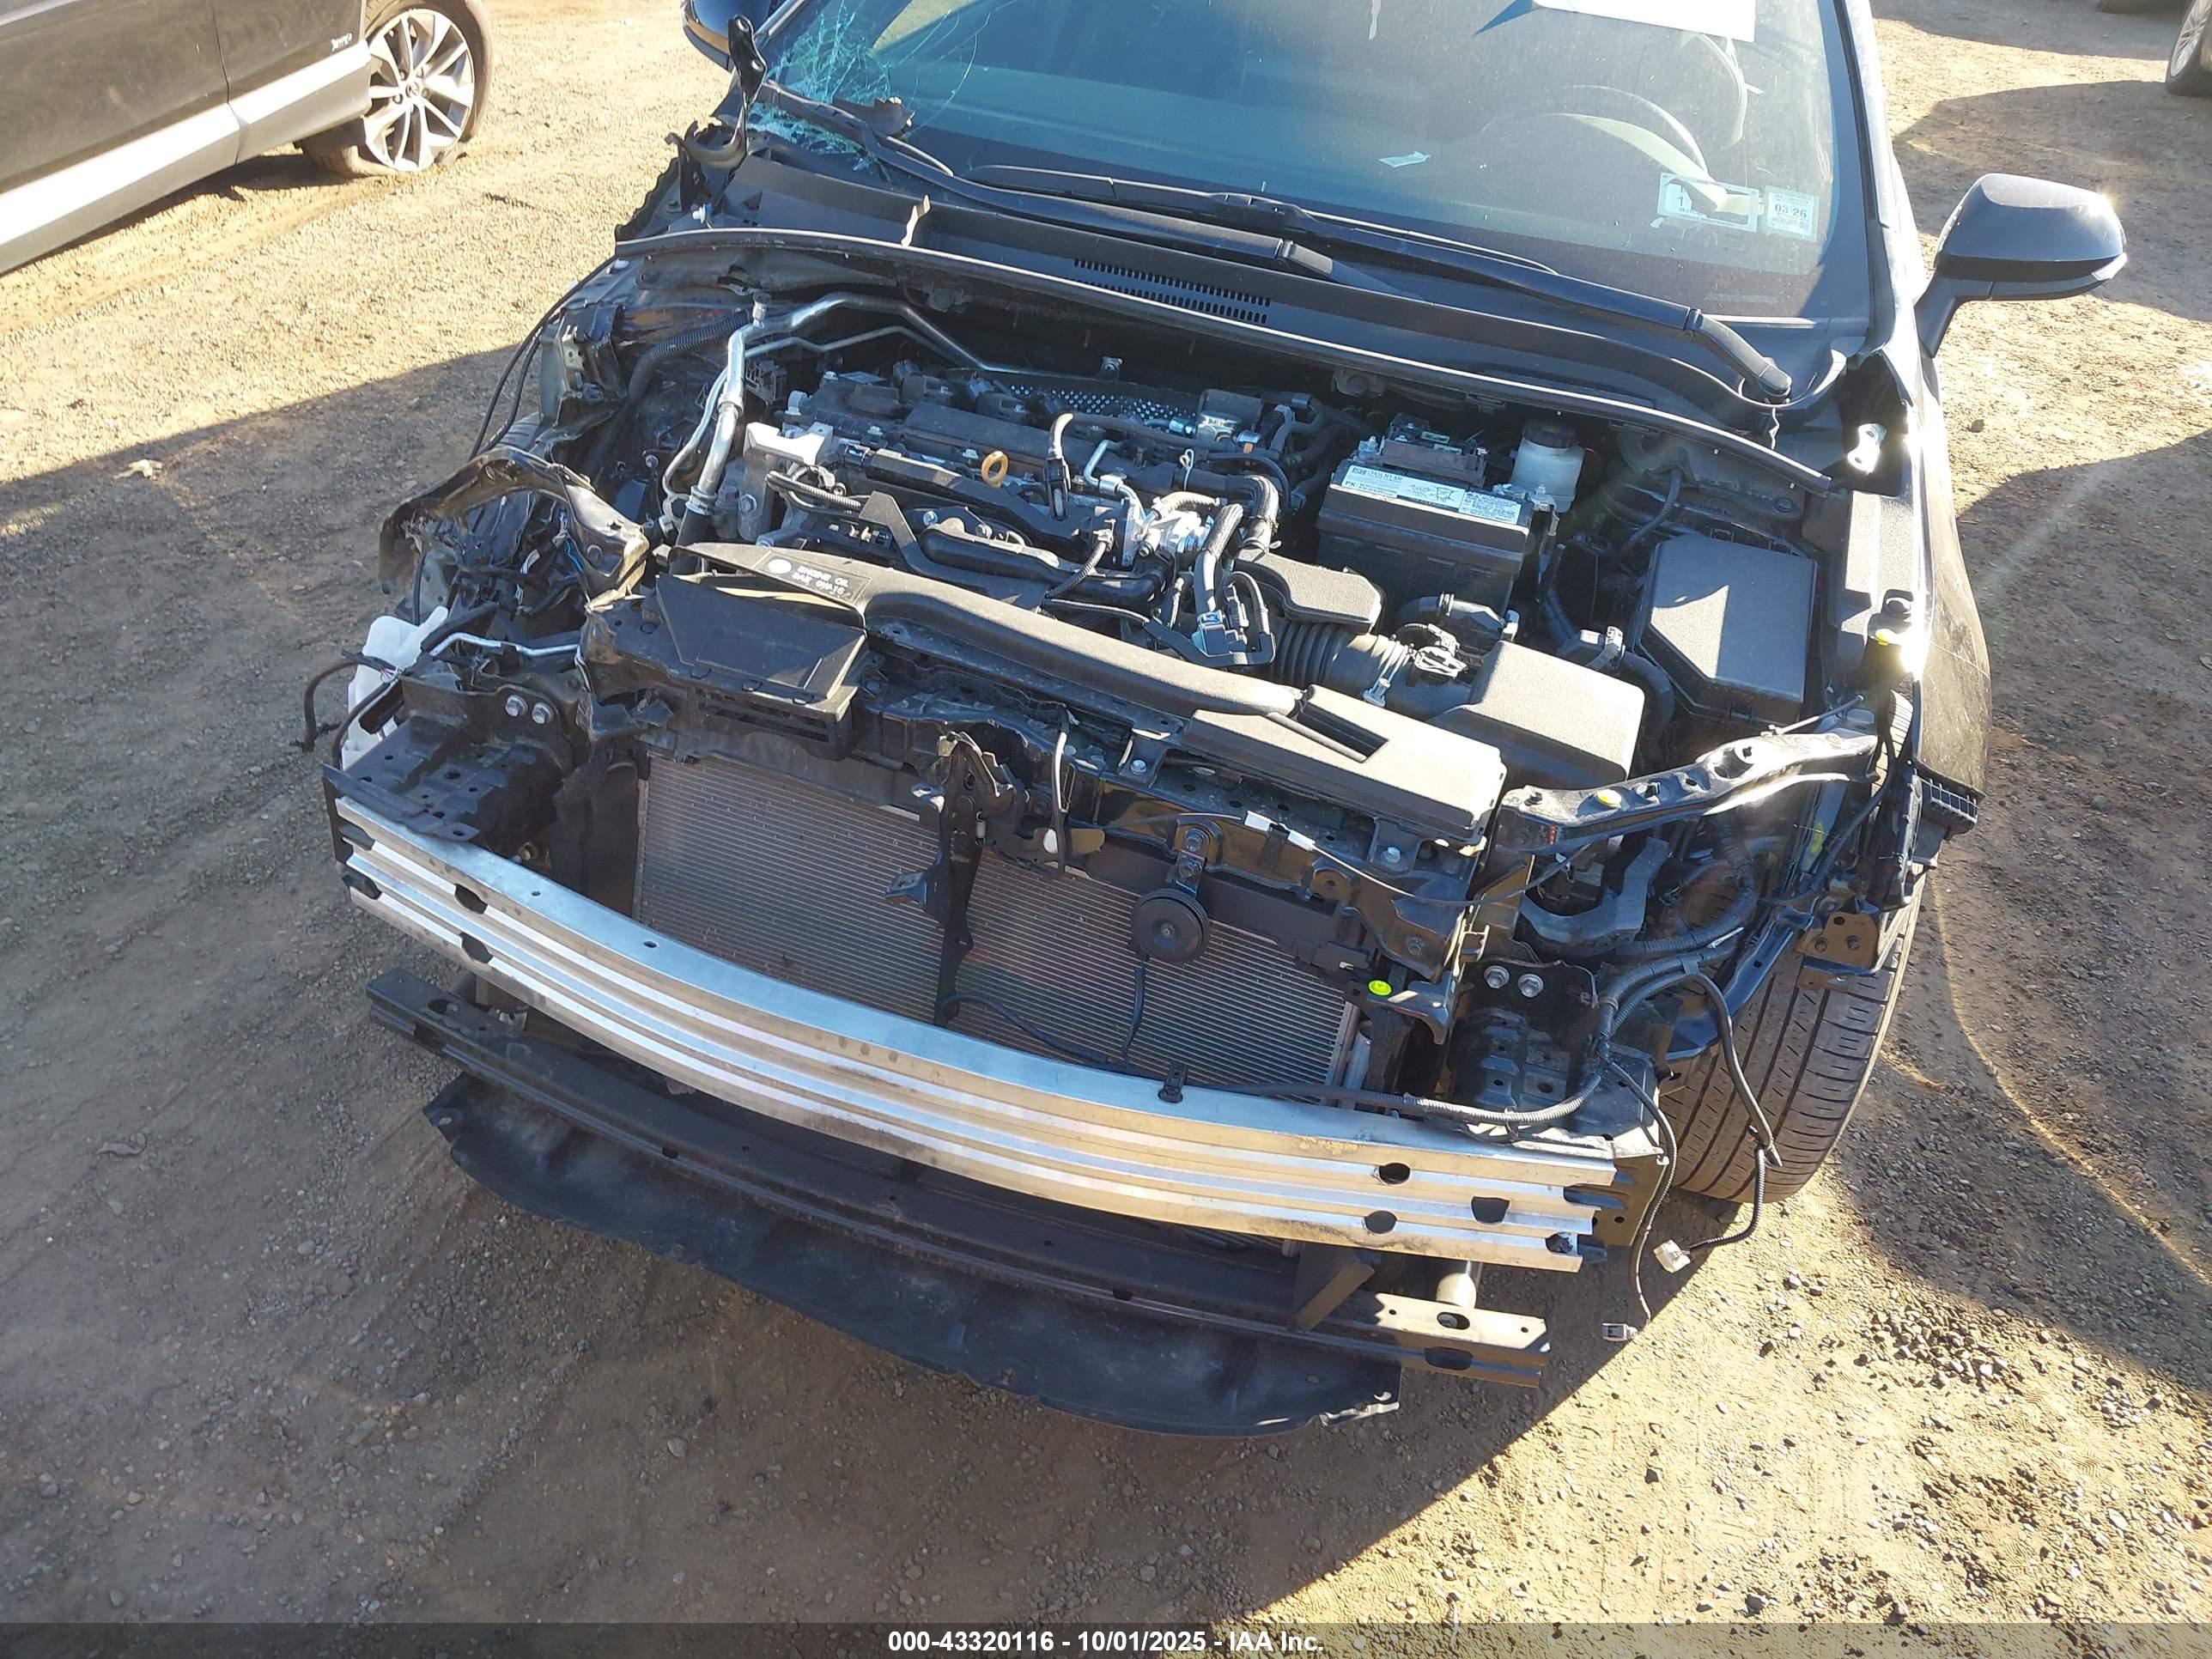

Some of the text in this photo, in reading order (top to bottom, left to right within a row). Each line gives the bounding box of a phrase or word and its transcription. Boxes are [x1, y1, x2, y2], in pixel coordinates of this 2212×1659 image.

[792, 572, 812, 586] SAE
[797, 565, 849, 587] ENGINE OIL
